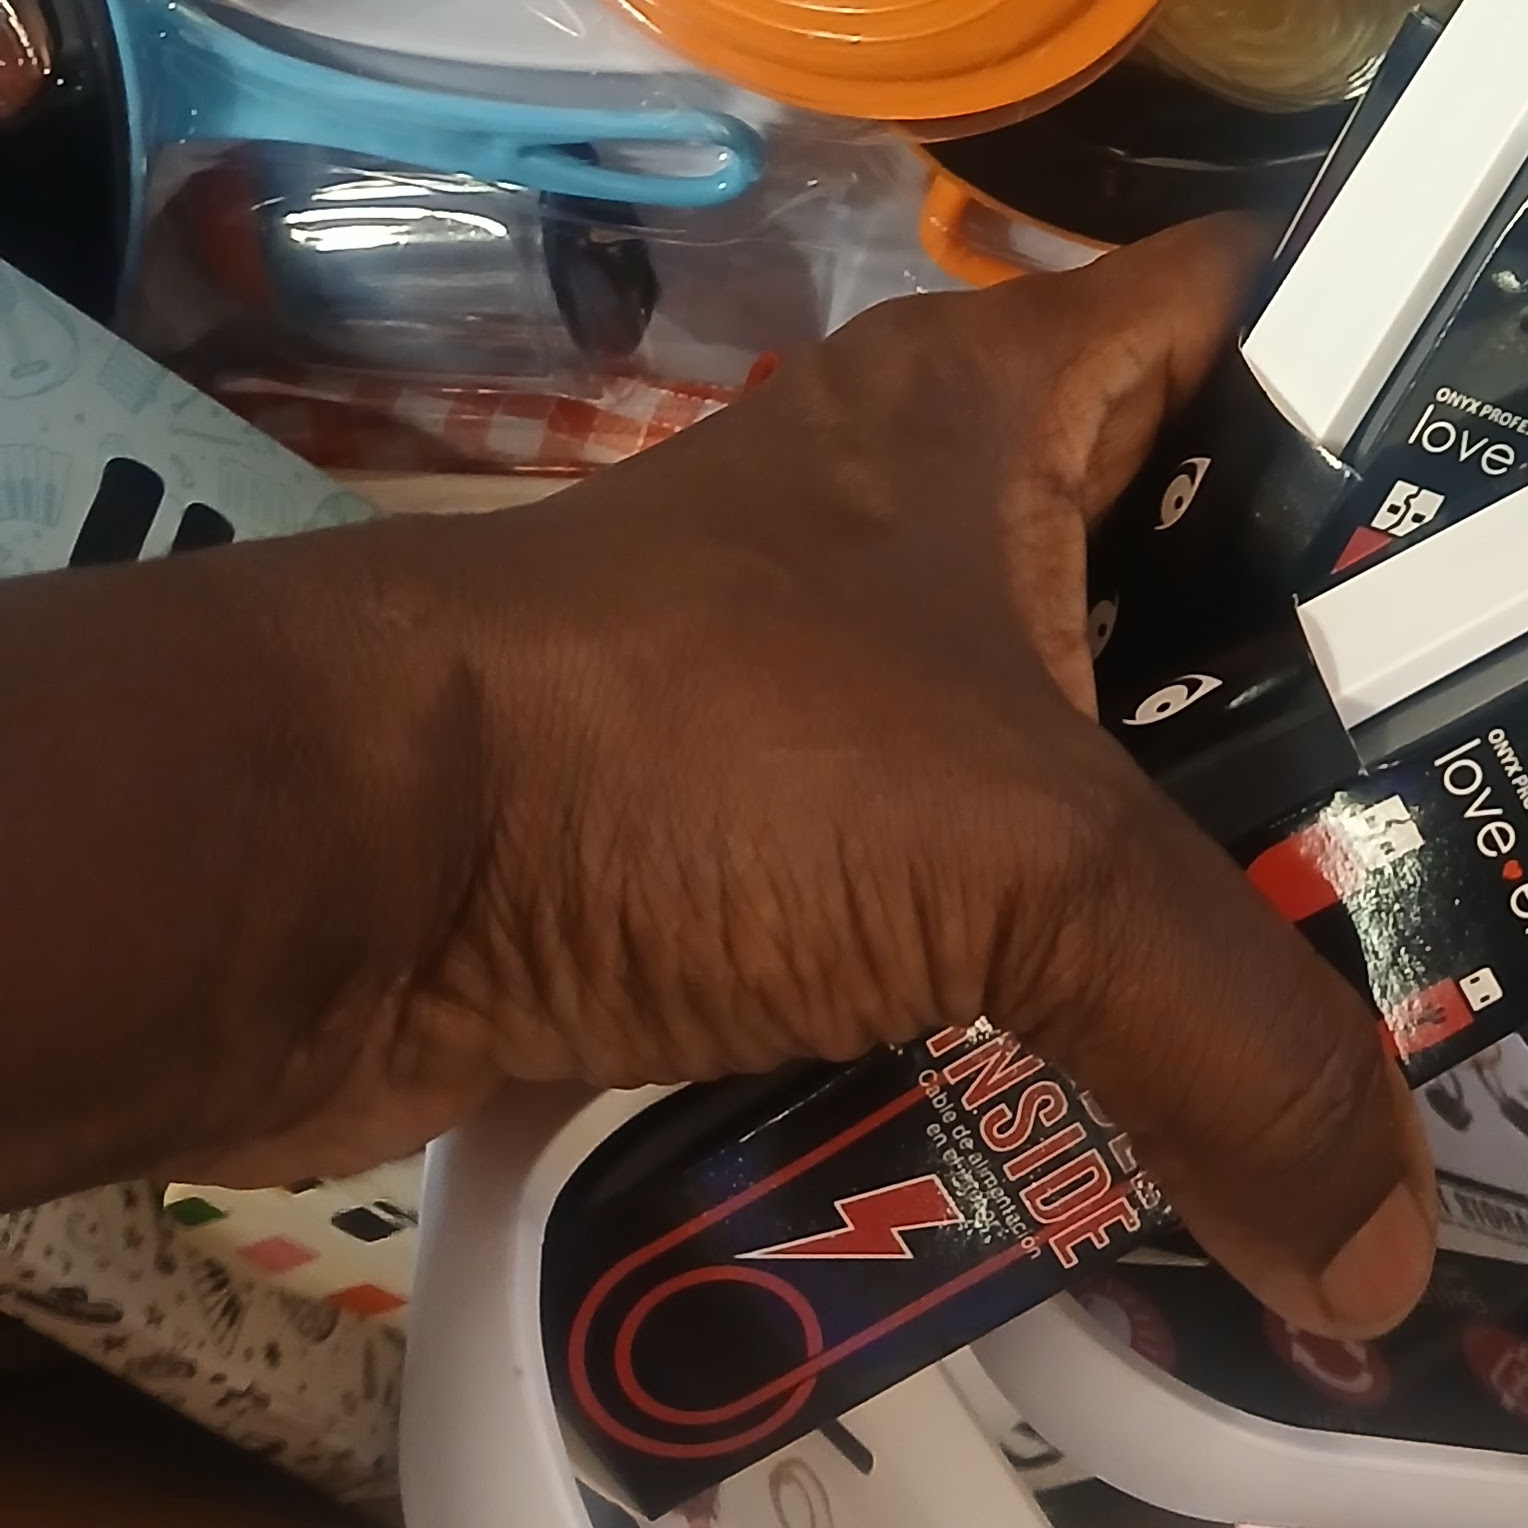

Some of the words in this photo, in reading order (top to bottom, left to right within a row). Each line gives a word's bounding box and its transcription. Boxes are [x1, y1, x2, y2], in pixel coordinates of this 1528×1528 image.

[1434, 386, 1481, 416] ONYX
[1406, 403, 1516, 476] love
[1487, 727, 1518, 778] ONYX
[1433, 736, 1518, 859] love
[918, 1069, 959, 1124] Cable
[952, 1125, 975, 1151] de
[926, 1122, 949, 1149] en
